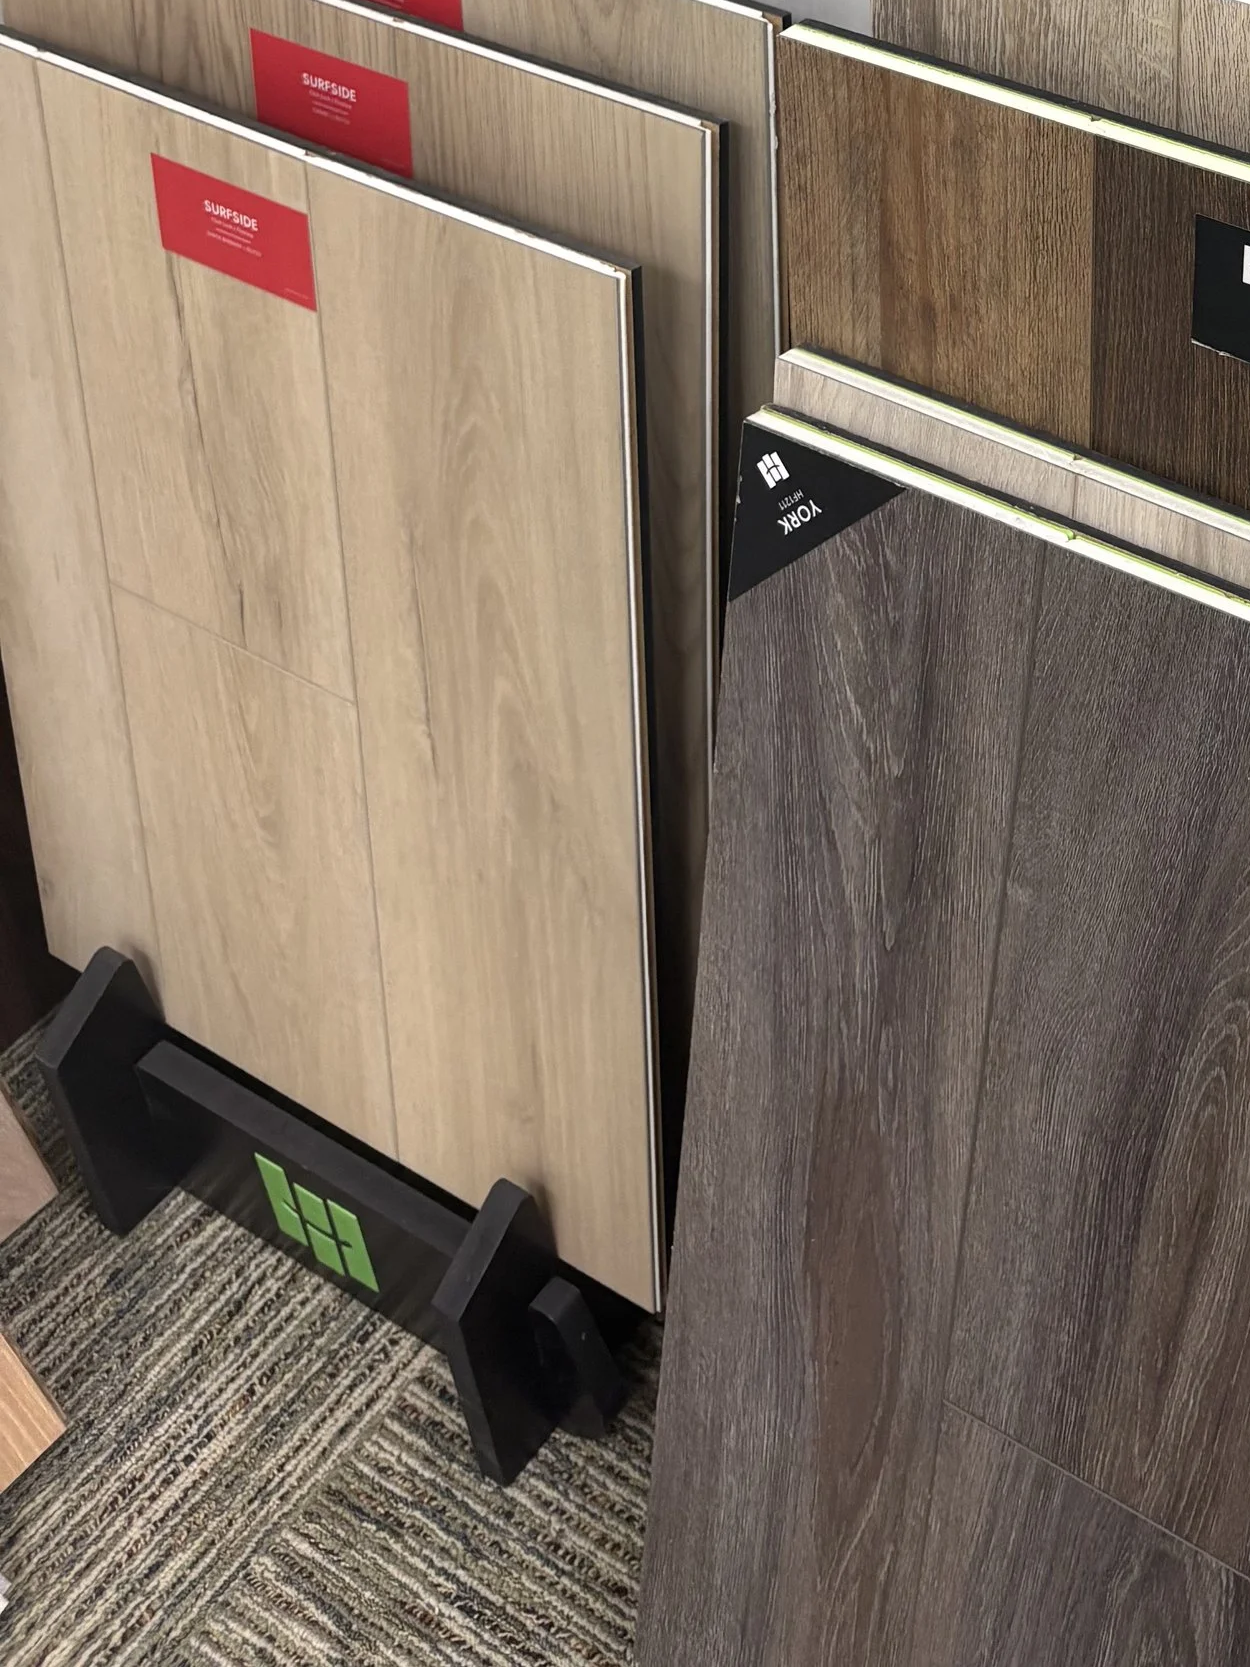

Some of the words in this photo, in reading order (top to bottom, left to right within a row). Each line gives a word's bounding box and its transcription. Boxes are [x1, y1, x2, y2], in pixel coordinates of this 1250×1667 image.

[302, 72, 356, 102] SURFSIDE
[203, 199, 259, 232] SURFSIDE
[778, 489, 805, 510] HF1211
[777, 499, 822, 535] YORK
